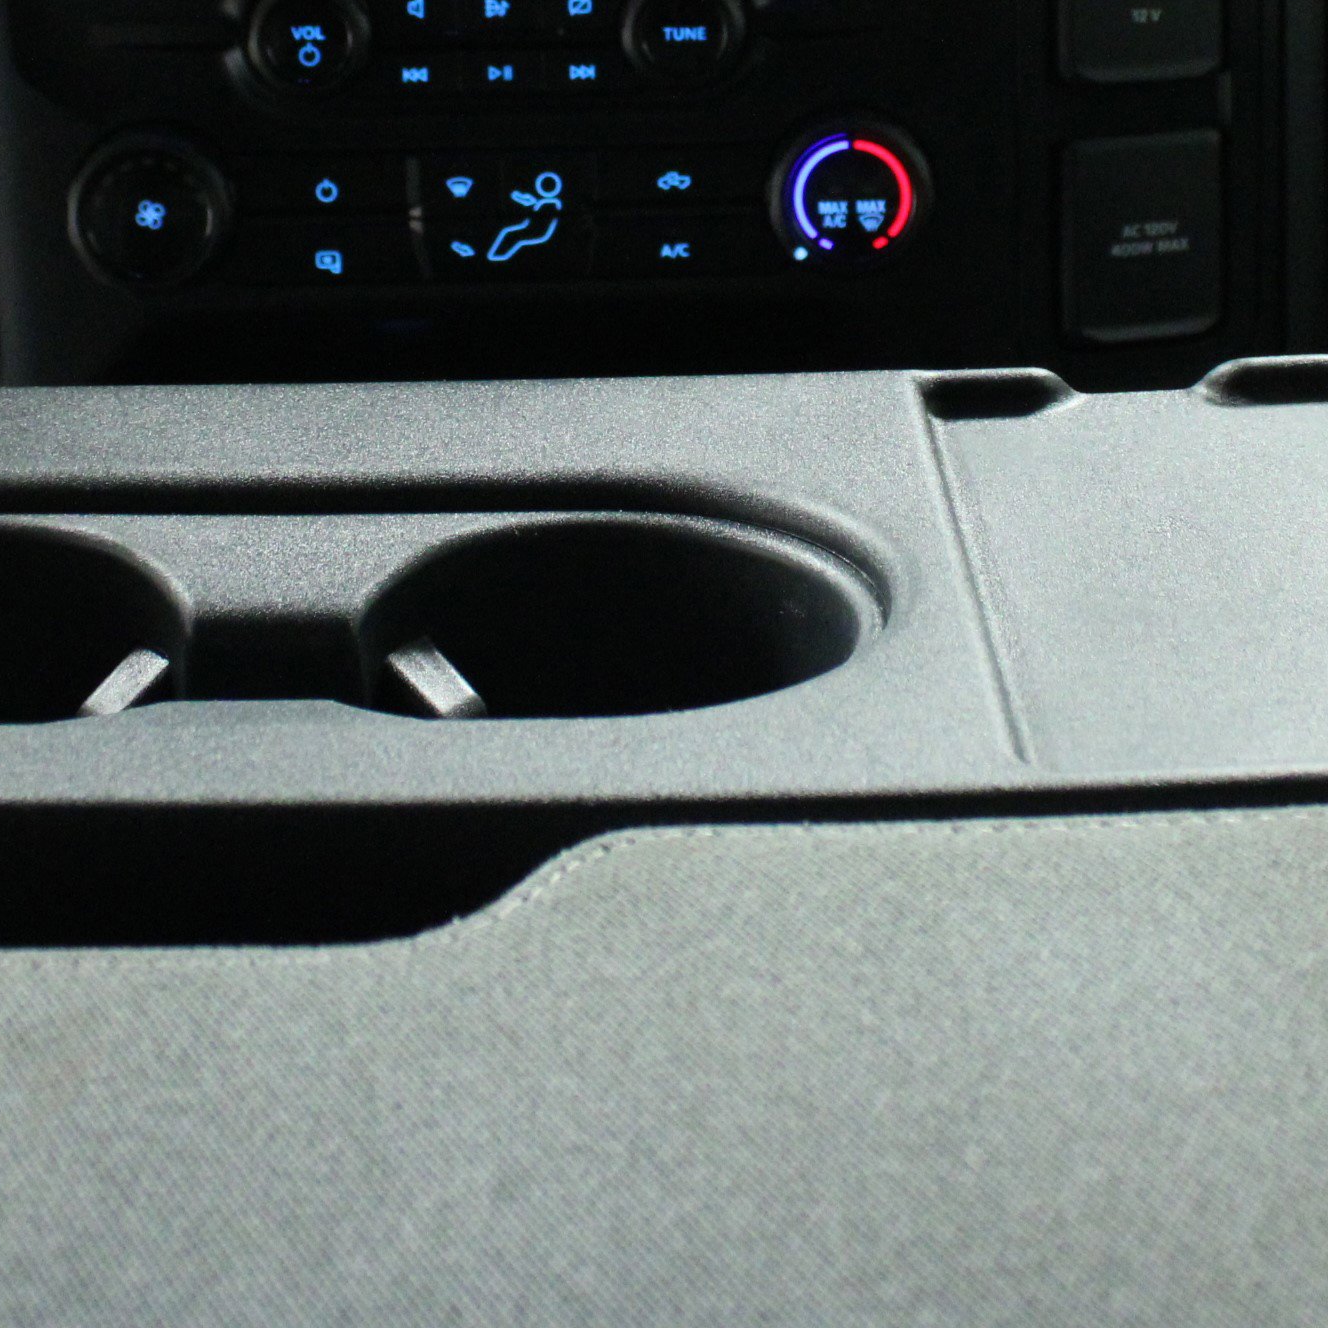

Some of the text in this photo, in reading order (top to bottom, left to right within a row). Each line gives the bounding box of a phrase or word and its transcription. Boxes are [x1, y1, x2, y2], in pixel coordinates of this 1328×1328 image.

[291, 25, 326, 40] VOL
[663, 27, 707, 42] TUNE
[817, 200, 849, 214] MAX
[855, 199, 887, 214] MAX
[823, 214, 847, 228] A/C
[661, 243, 691, 258] A/C
